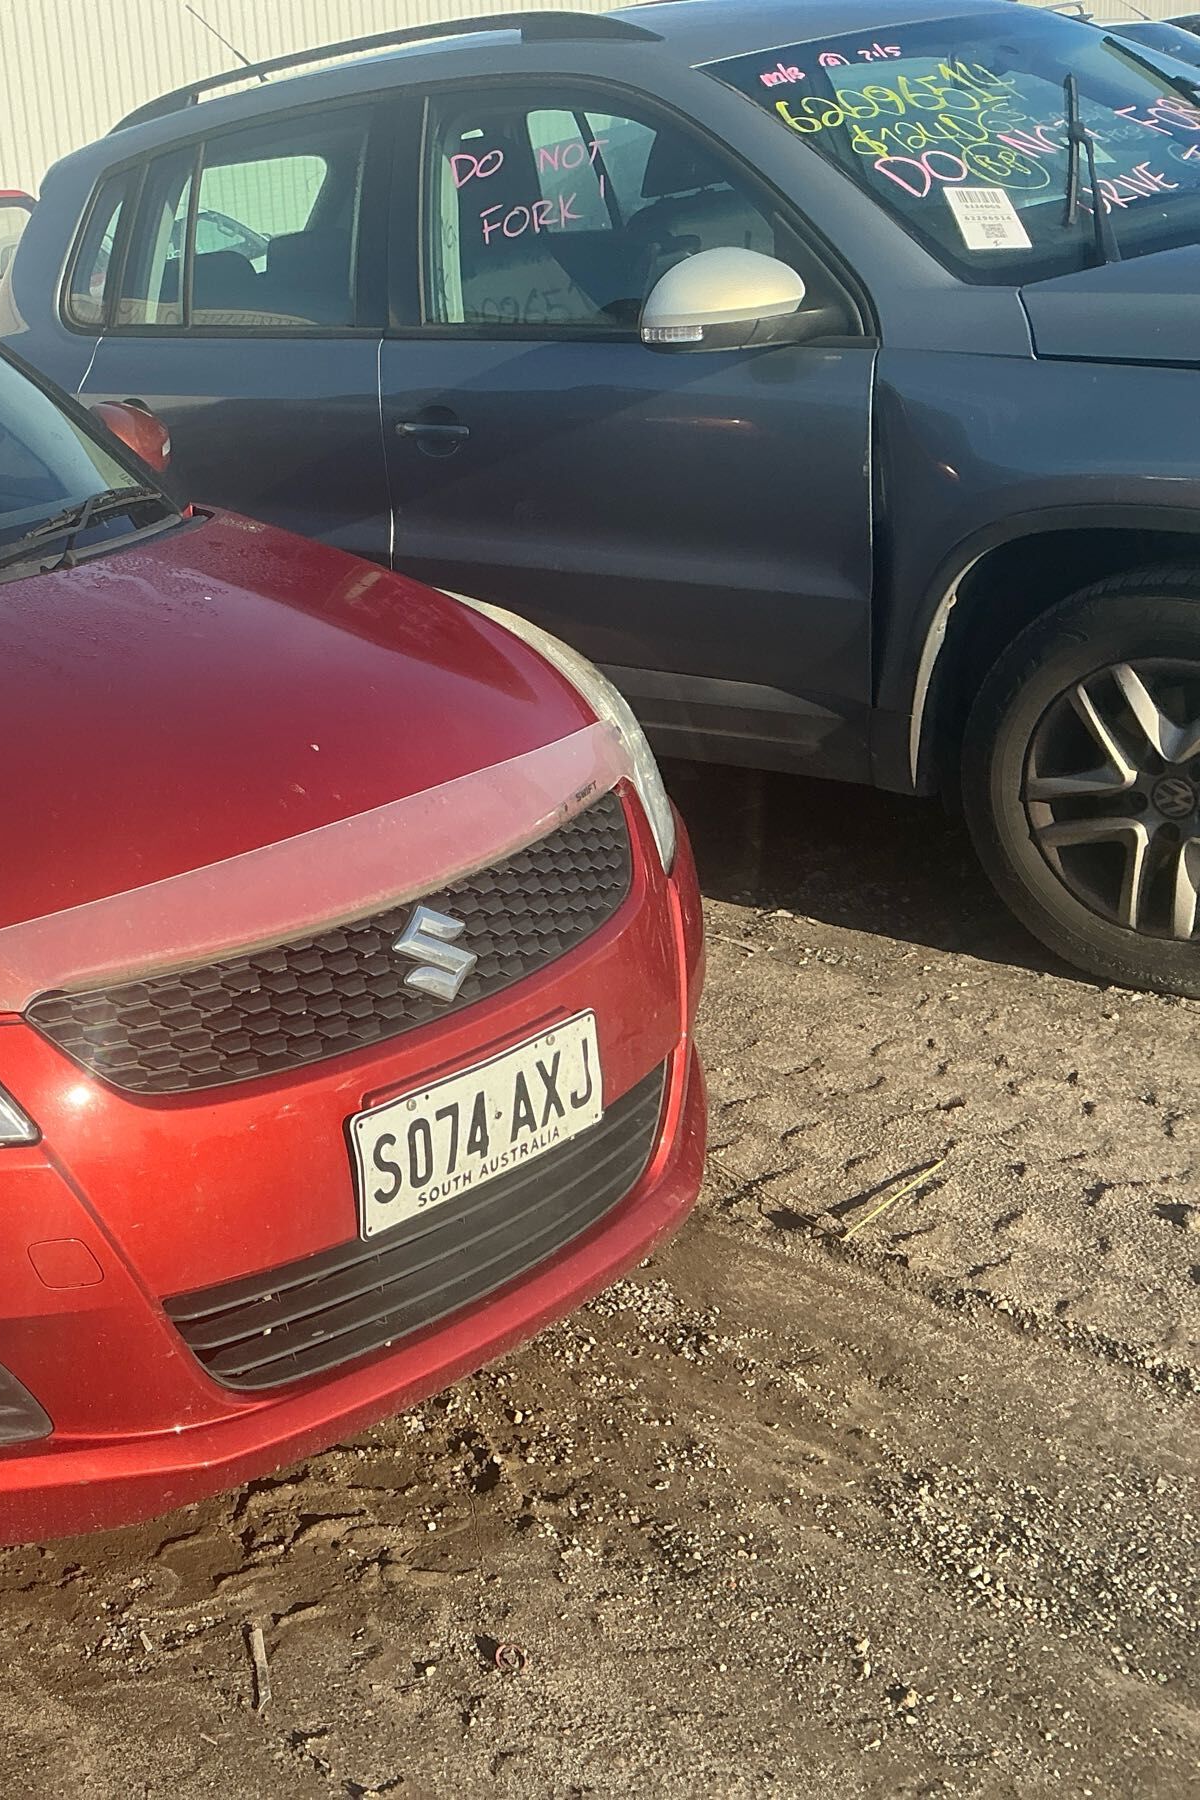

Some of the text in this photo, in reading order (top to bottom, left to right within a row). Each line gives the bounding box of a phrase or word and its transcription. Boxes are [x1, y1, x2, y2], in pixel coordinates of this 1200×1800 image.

[450, 139, 610, 189] DO NOT
[874, 150, 968, 198] DO
[479, 192, 585, 245] FORK
[575, 779, 597, 802] SWIFT
[417, 1125, 561, 1208] SOUTH AUSTRALIA
